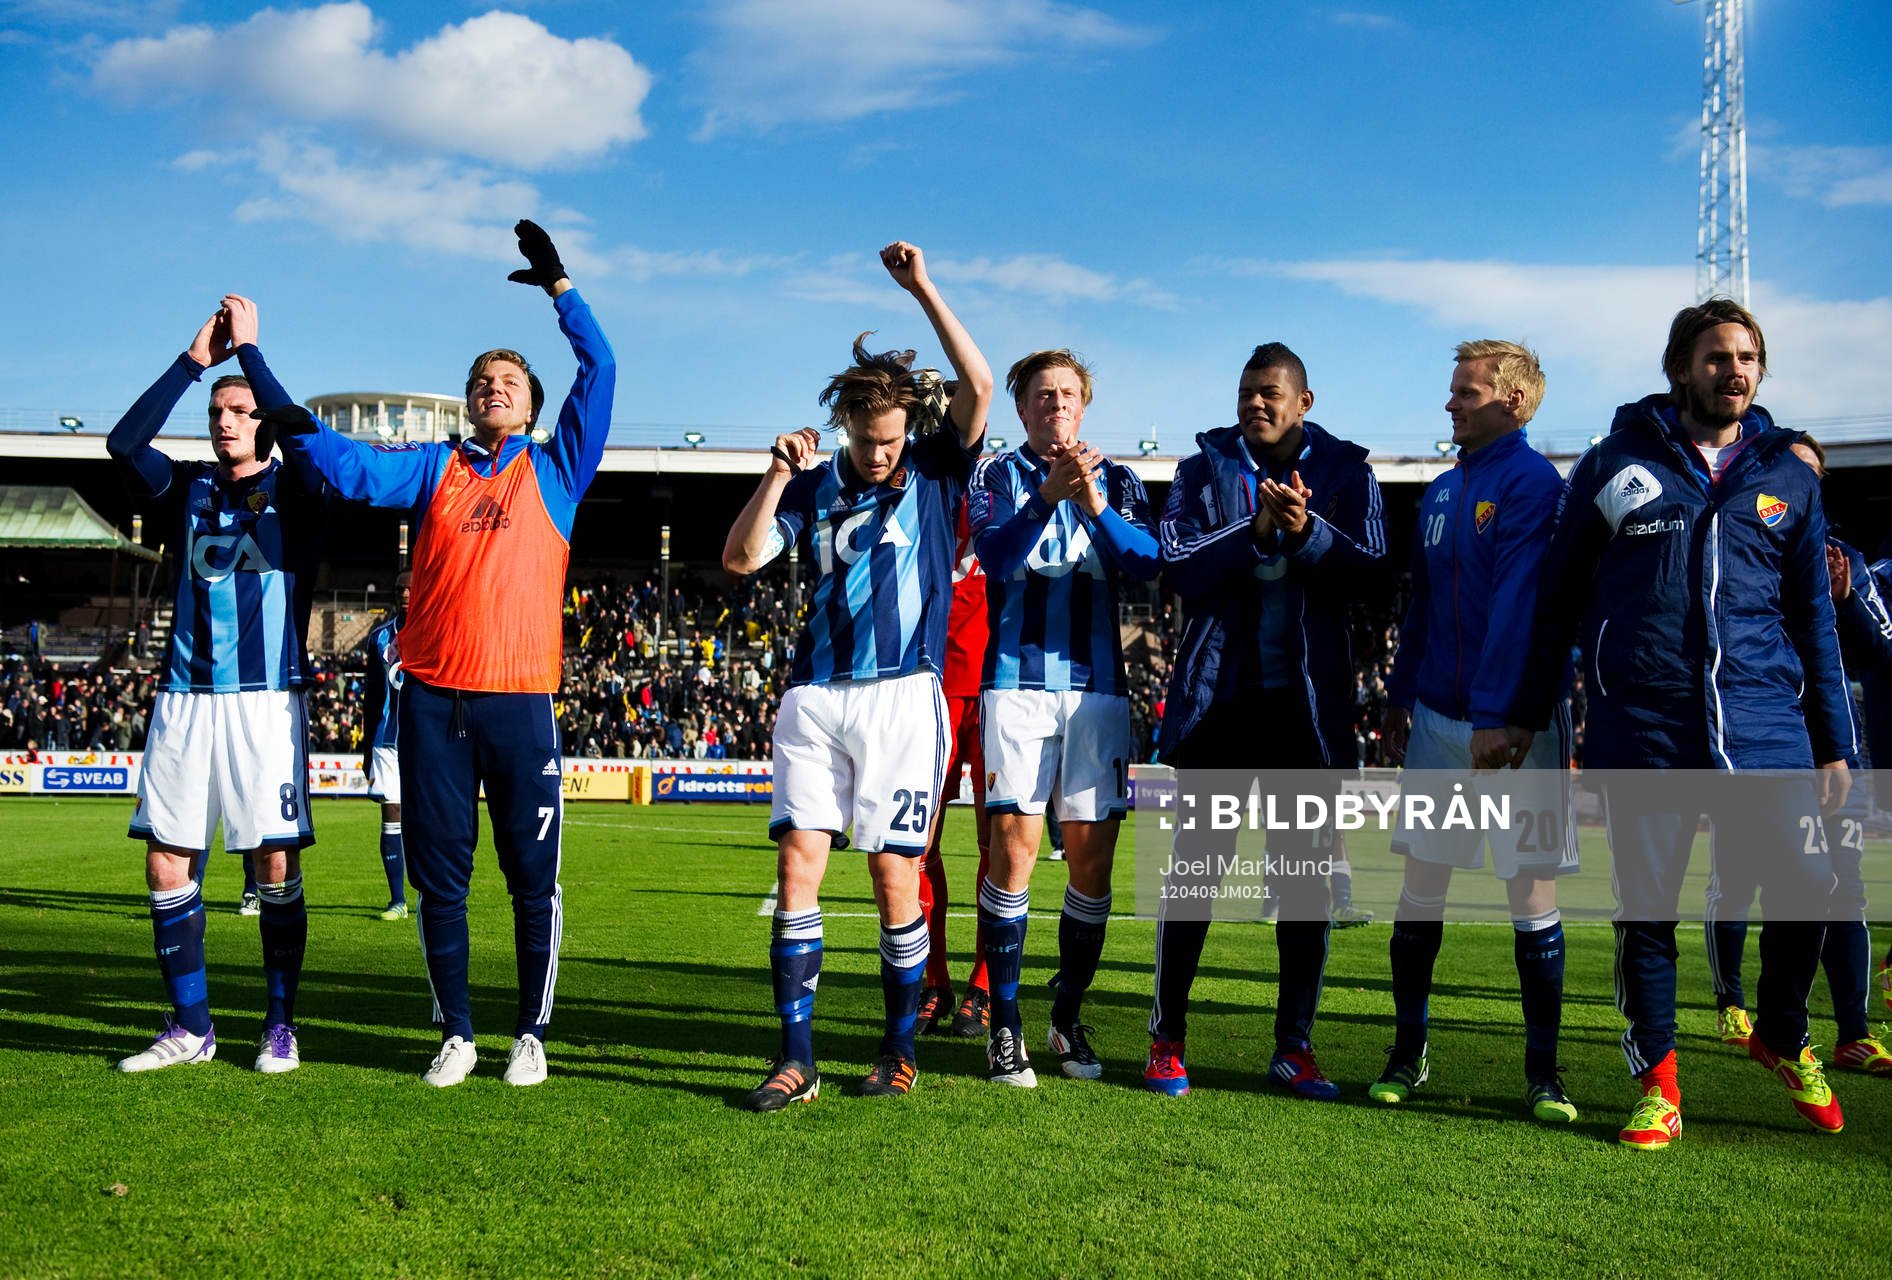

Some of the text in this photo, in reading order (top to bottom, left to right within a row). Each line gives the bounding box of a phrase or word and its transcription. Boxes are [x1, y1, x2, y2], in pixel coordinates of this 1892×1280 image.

[1621, 487, 1649, 497] adidas
[816, 504, 913, 575] ICA
[1424, 513, 1445, 547] 20
[1625, 519, 1685, 535] stadium
[73, 772, 123, 785] SVEAB
[280, 783, 298, 822] 8
[890, 789, 929, 834] 25
[537, 807, 554, 841] 7
[1514, 809, 1560, 853] 20
[1799, 815, 1829, 854] 23
